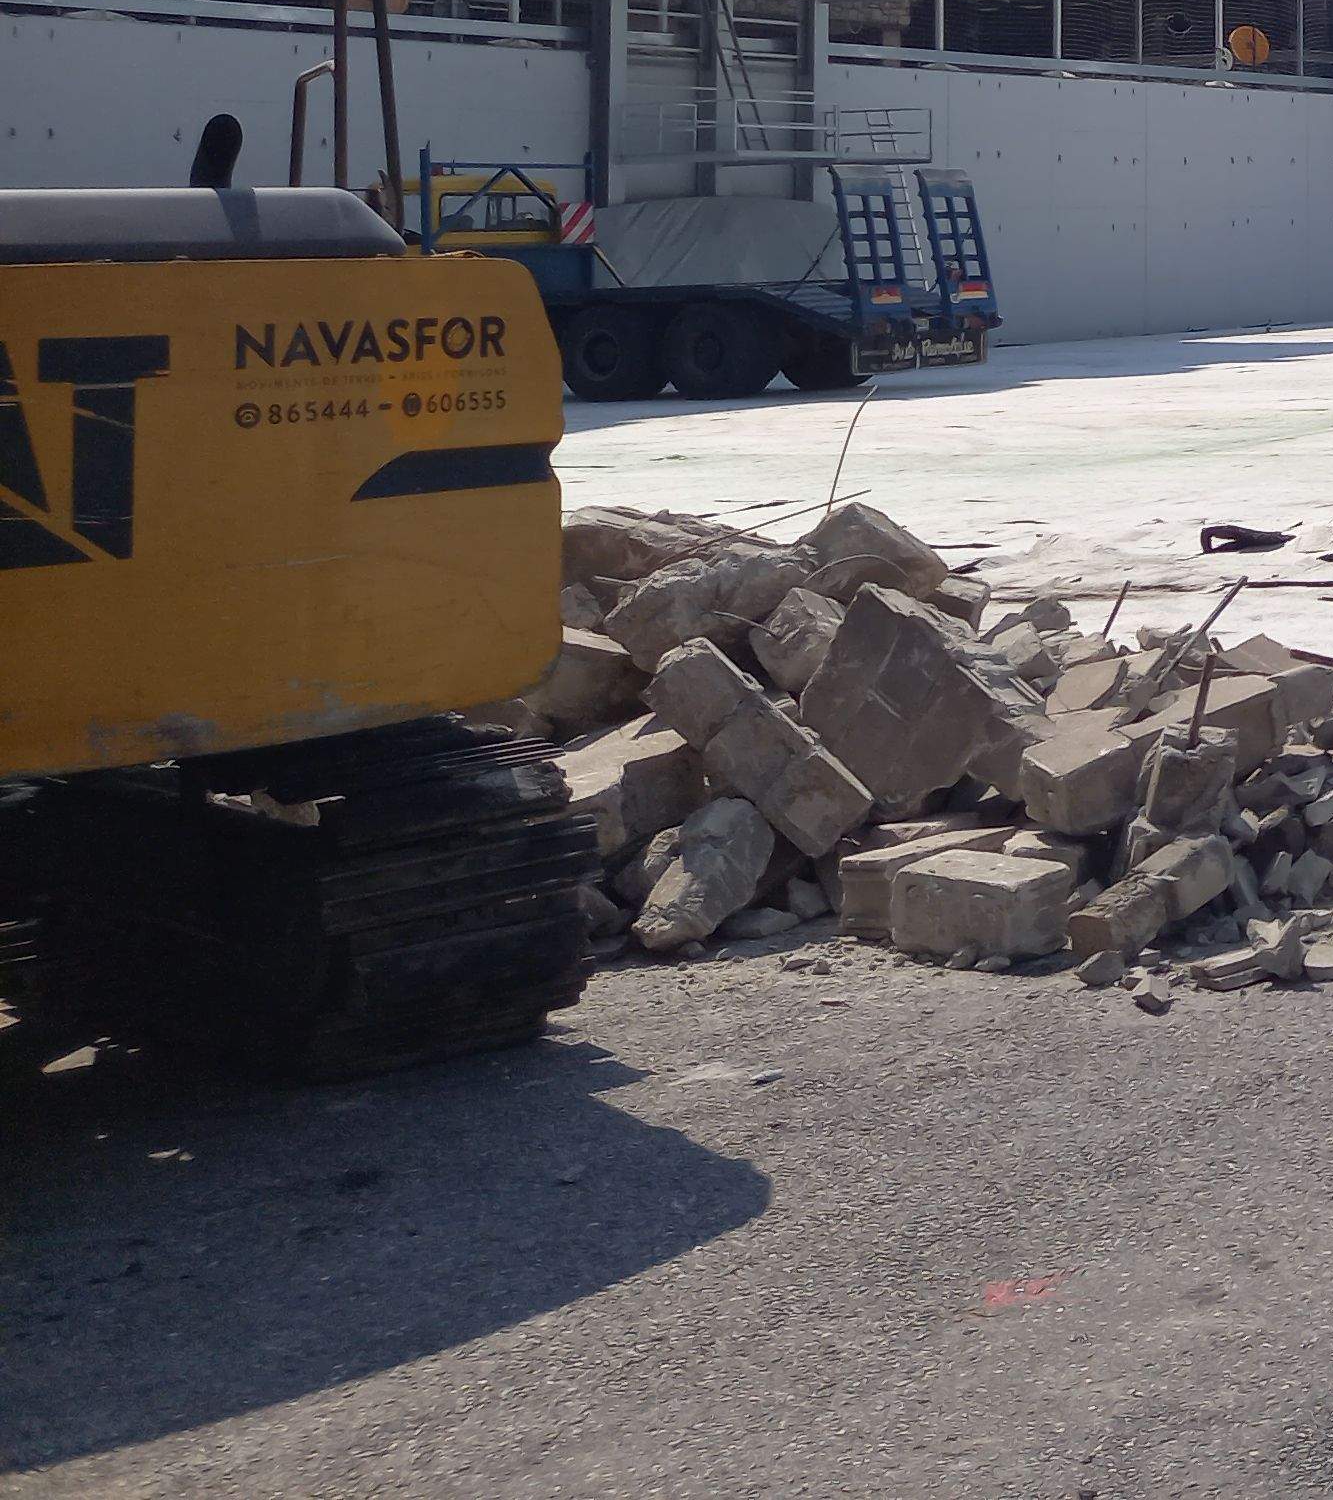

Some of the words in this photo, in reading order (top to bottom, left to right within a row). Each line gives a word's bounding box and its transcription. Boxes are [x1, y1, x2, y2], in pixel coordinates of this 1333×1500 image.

[235, 316, 506, 369] NAVASFOR
[267, 398, 371, 425] 865444
[426, 389, 507, 414] 606555
